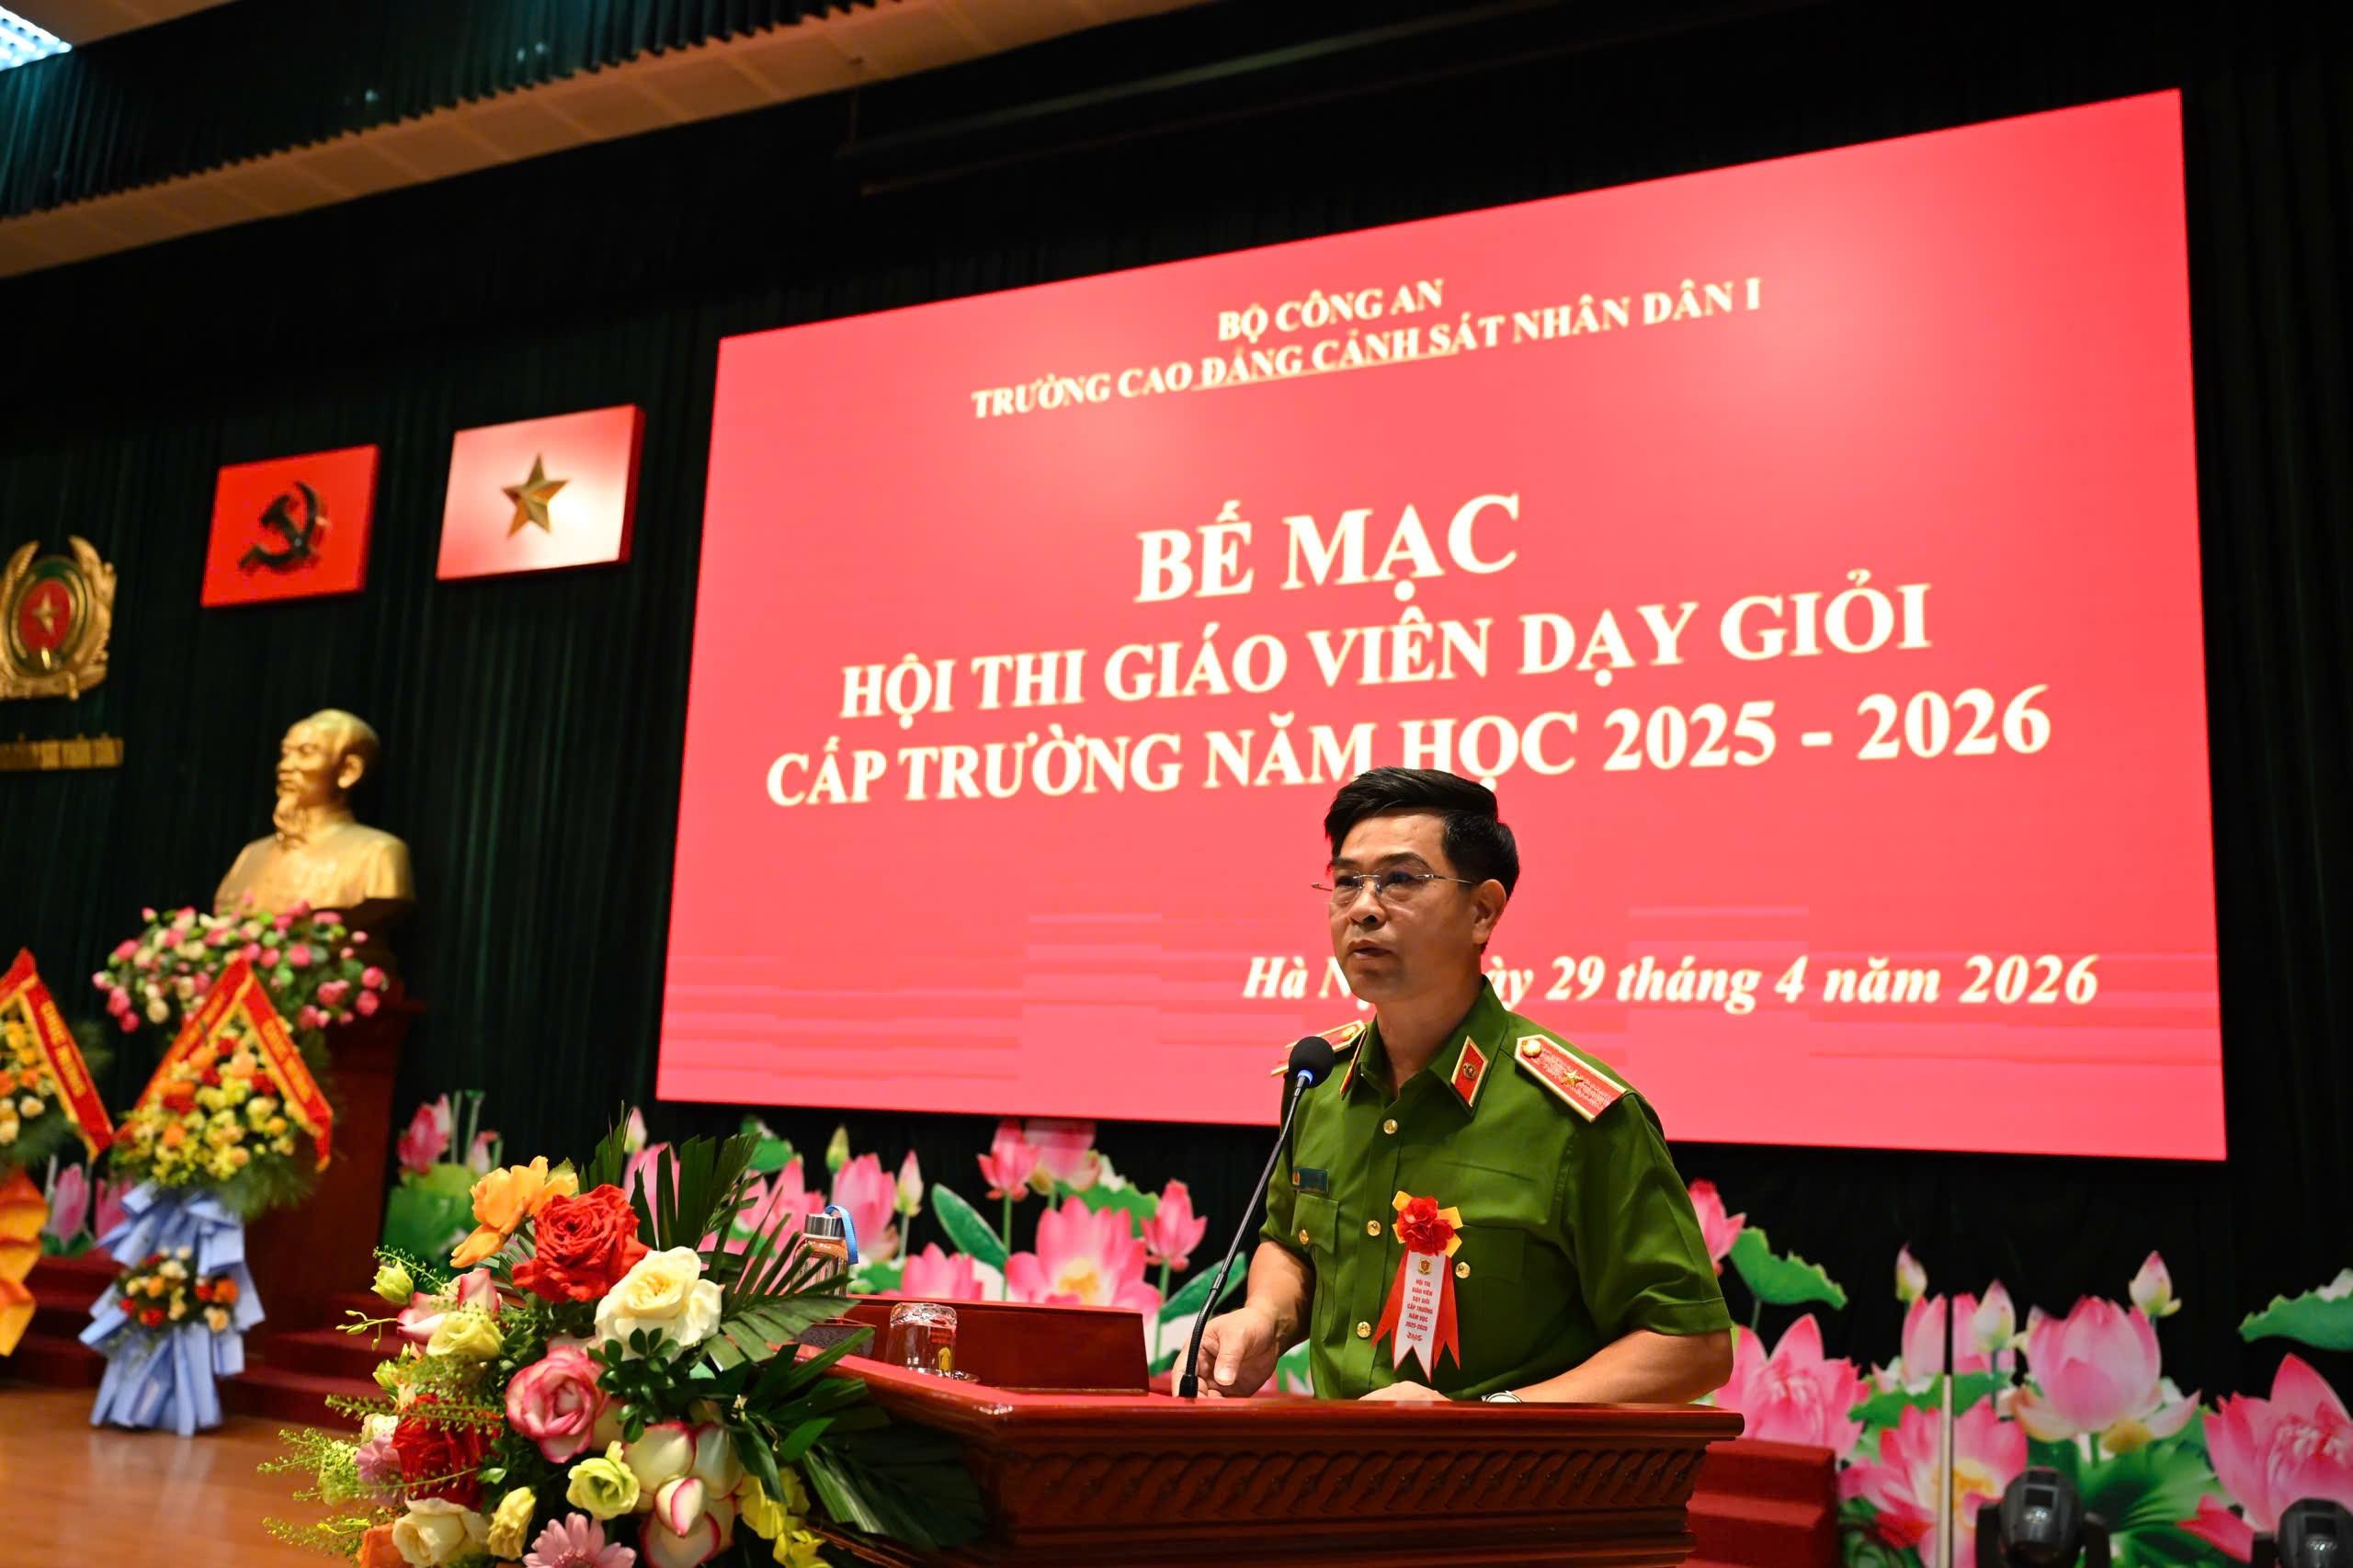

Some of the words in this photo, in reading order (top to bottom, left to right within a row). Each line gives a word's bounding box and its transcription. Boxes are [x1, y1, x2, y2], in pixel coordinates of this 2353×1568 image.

[971, 372, 1111, 418] TRƯỜNG
[1117, 362, 1194, 398] CAO
[1199, 345, 1304, 387] ĐẢNG
[1311, 328, 1421, 369] CẢNH
[1427, 311, 1506, 356] SÁT
[1513, 294, 1630, 343] NHÂN
[1643, 278, 1733, 324] DÂN
[1745, 277, 1761, 311] I
[1219, 303, 1268, 343] BỘ
[1275, 289, 1383, 332] CÔNG
[1391, 279, 1443, 314] AN
[1134, 500, 1254, 603] BẾ
[1281, 494, 1518, 601] MẠC
[840, 653, 956, 729] HỘI
[971, 649, 1086, 710] THI
[1104, 622, 1287, 701] GIÁO
[1306, 606, 1493, 687] VIÊN
[1518, 602, 1699, 687] DẠY
[1721, 569, 1930, 660] GIỎI
[767, 736, 886, 806] CẤP
[898, 723, 1183, 801] TRƯỜNG
[1204, 711, 1376, 788] NĂM
[1399, 711, 1577, 791] HỌC
[1603, 700, 1776, 771] 2025
[1802, 732, 1832, 746] -
[1858, 685, 2050, 759] 2026
[1243, 956, 1308, 998] Hà
[1546, 956, 1605, 1000] 29
[1617, 956, 1761, 1015] tháng
[1775, 956, 1808, 1003] 4
[1824, 957, 1940, 1003] năm
[1960, 955, 2097, 1004] 2026
